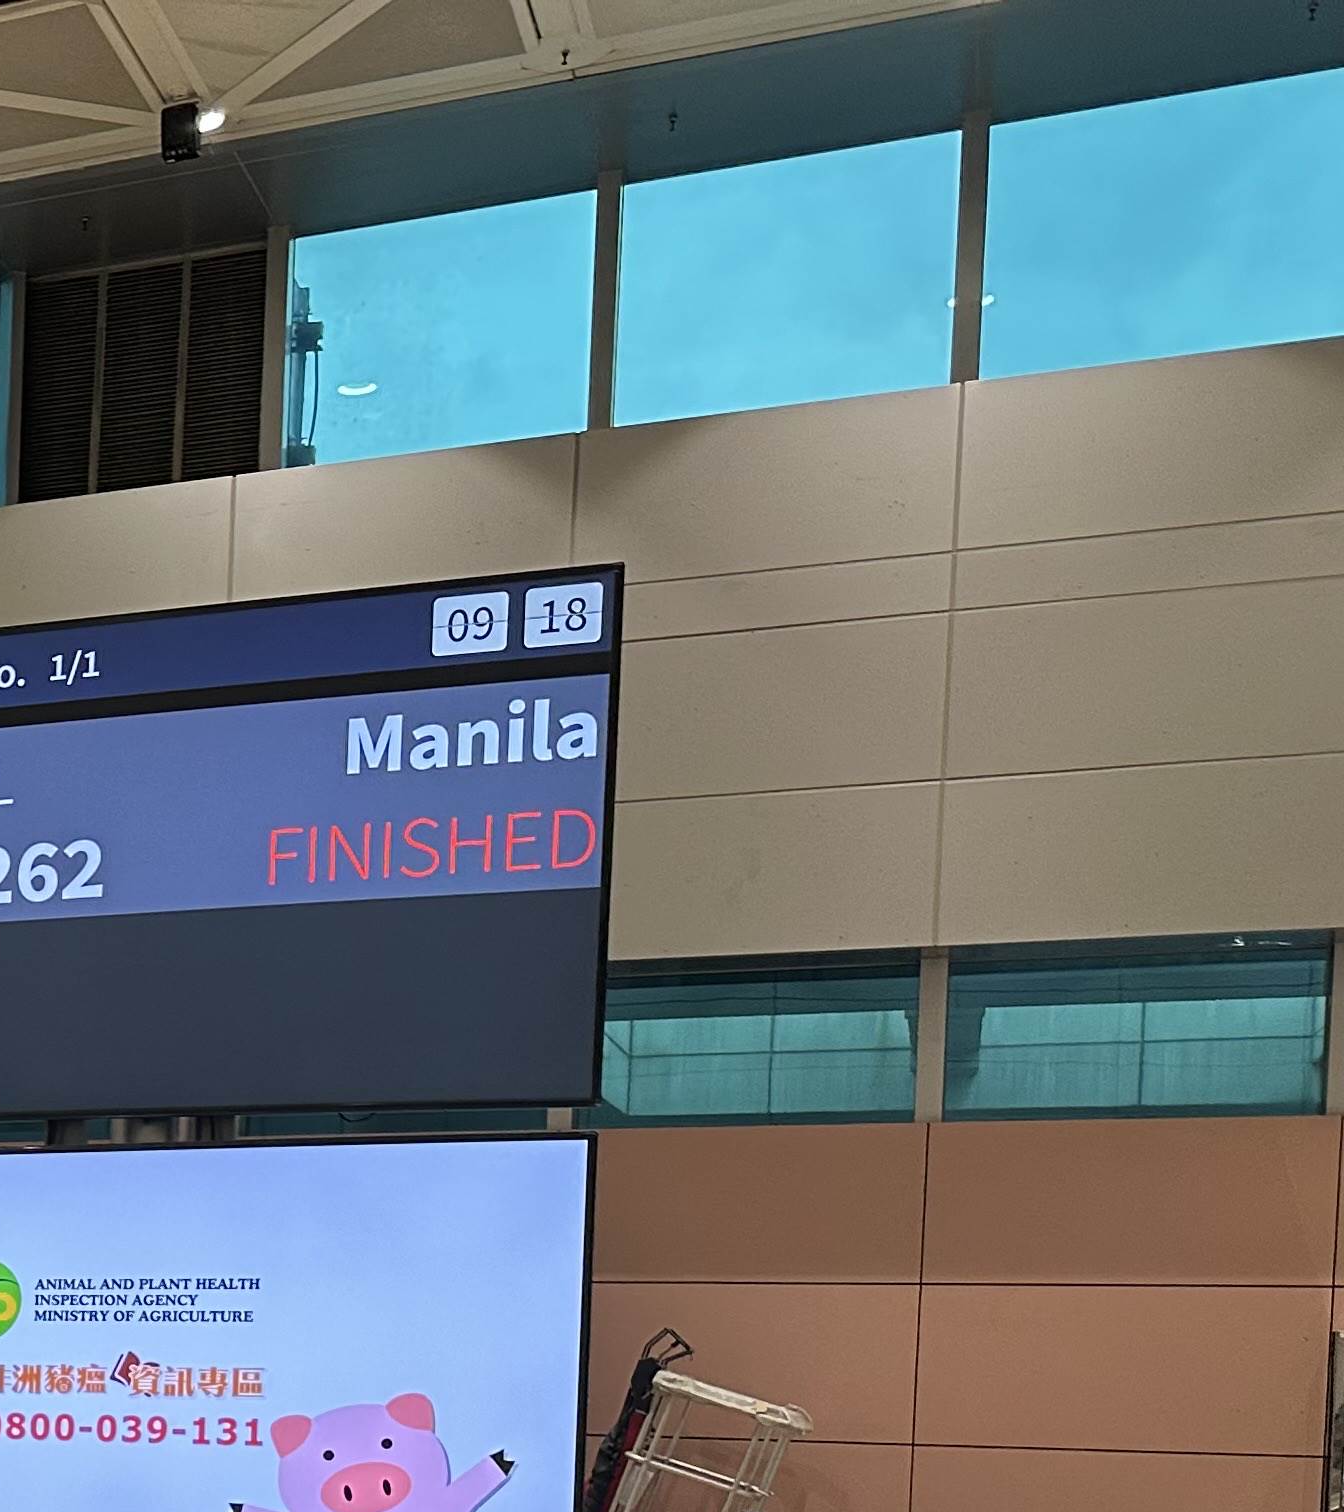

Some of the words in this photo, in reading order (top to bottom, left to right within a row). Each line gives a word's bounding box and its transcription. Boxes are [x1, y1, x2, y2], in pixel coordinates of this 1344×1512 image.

[448, 607, 494, 643] 09
[539, 597, 590, 634] 18
[49, 649, 100, 685] 1/1
[345, 698, 598, 776] Manila
[267, 808, 597, 886] FINISHED
[34, 1278, 97, 1291] ANIMAL
[99, 1278, 135, 1291] AND
[138, 1278, 192, 1291] PLANT
[195, 1277, 261, 1291] HEALTH
[34, 1293, 128, 1307] INSPECTION
[131, 1293, 199, 1307] AGENCY
[33, 1309, 110, 1323] MINISTRY
[113, 1310, 135, 1323] OF
[137, 1310, 254, 1323] AGRICULTURE
